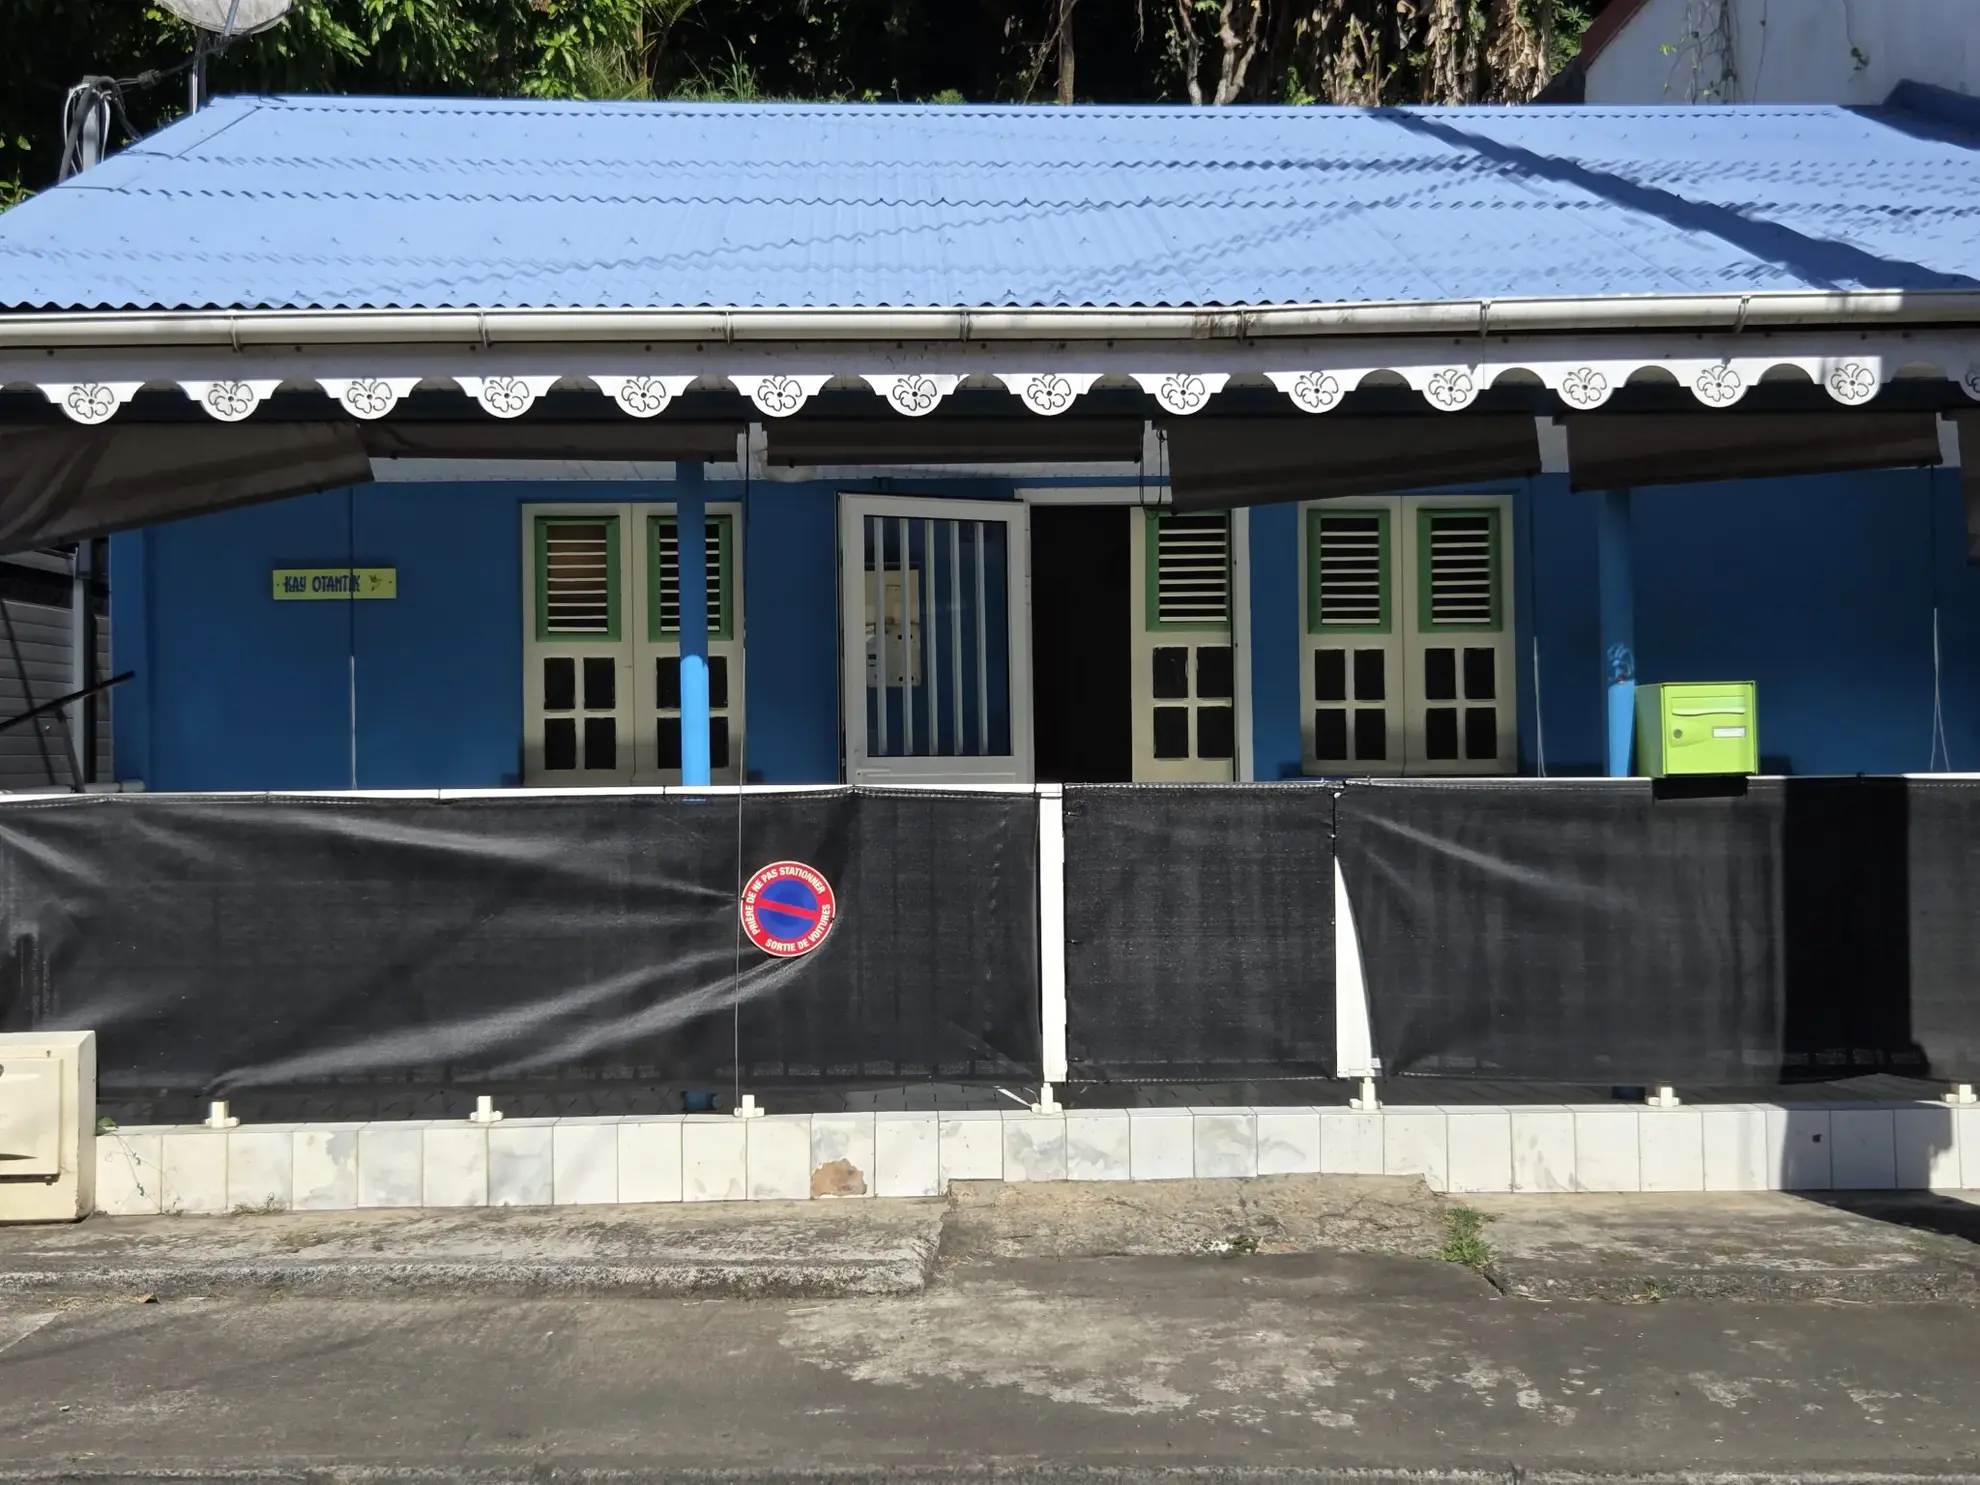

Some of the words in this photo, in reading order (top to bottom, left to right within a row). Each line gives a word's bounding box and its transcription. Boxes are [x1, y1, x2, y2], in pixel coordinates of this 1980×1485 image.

[284, 576, 306, 592] KAY
[746, 891, 756, 904] DE
[751, 879, 764, 893] NE
[761, 869, 778, 883] PAS
[779, 867, 826, 894] STATIONNER
[765, 939, 796, 952] SORTIE
[797, 938, 810, 950] DE
[808, 904, 831, 943] VOITURES
